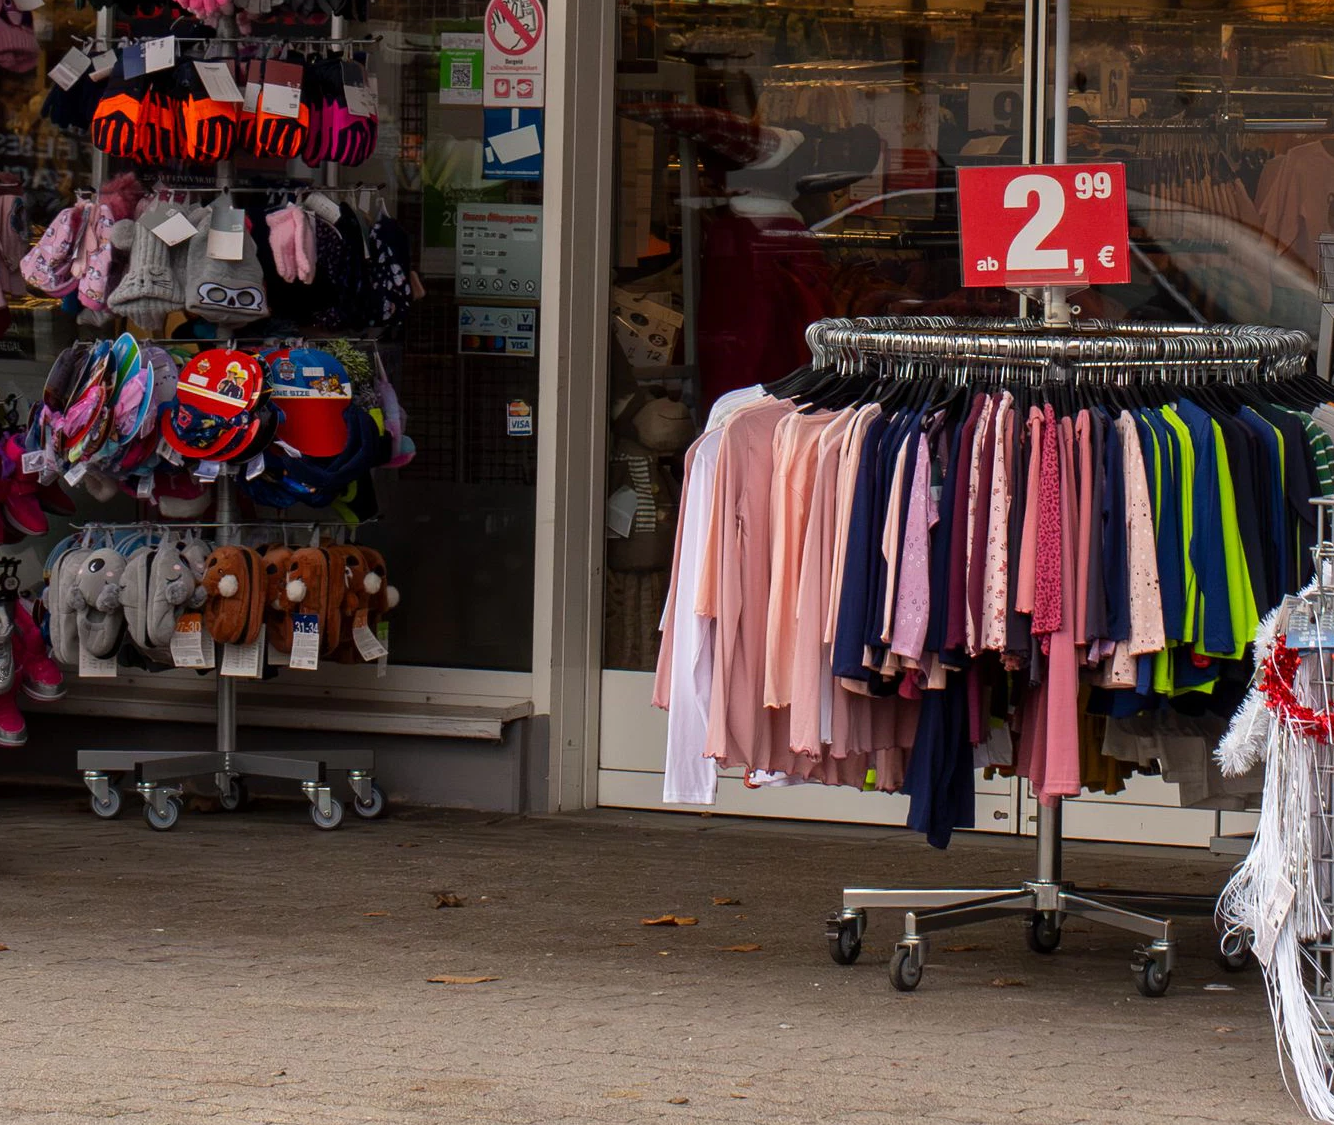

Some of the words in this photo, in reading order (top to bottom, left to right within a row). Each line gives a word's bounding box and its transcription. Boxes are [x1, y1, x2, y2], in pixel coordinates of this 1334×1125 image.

[977, 256, 999, 271] ab
[1097, 245, 1115, 268] €
[511, 341, 528, 349] VISA
[511, 420, 530, 429] VISA
[295, 621, 318, 633] 31-34
